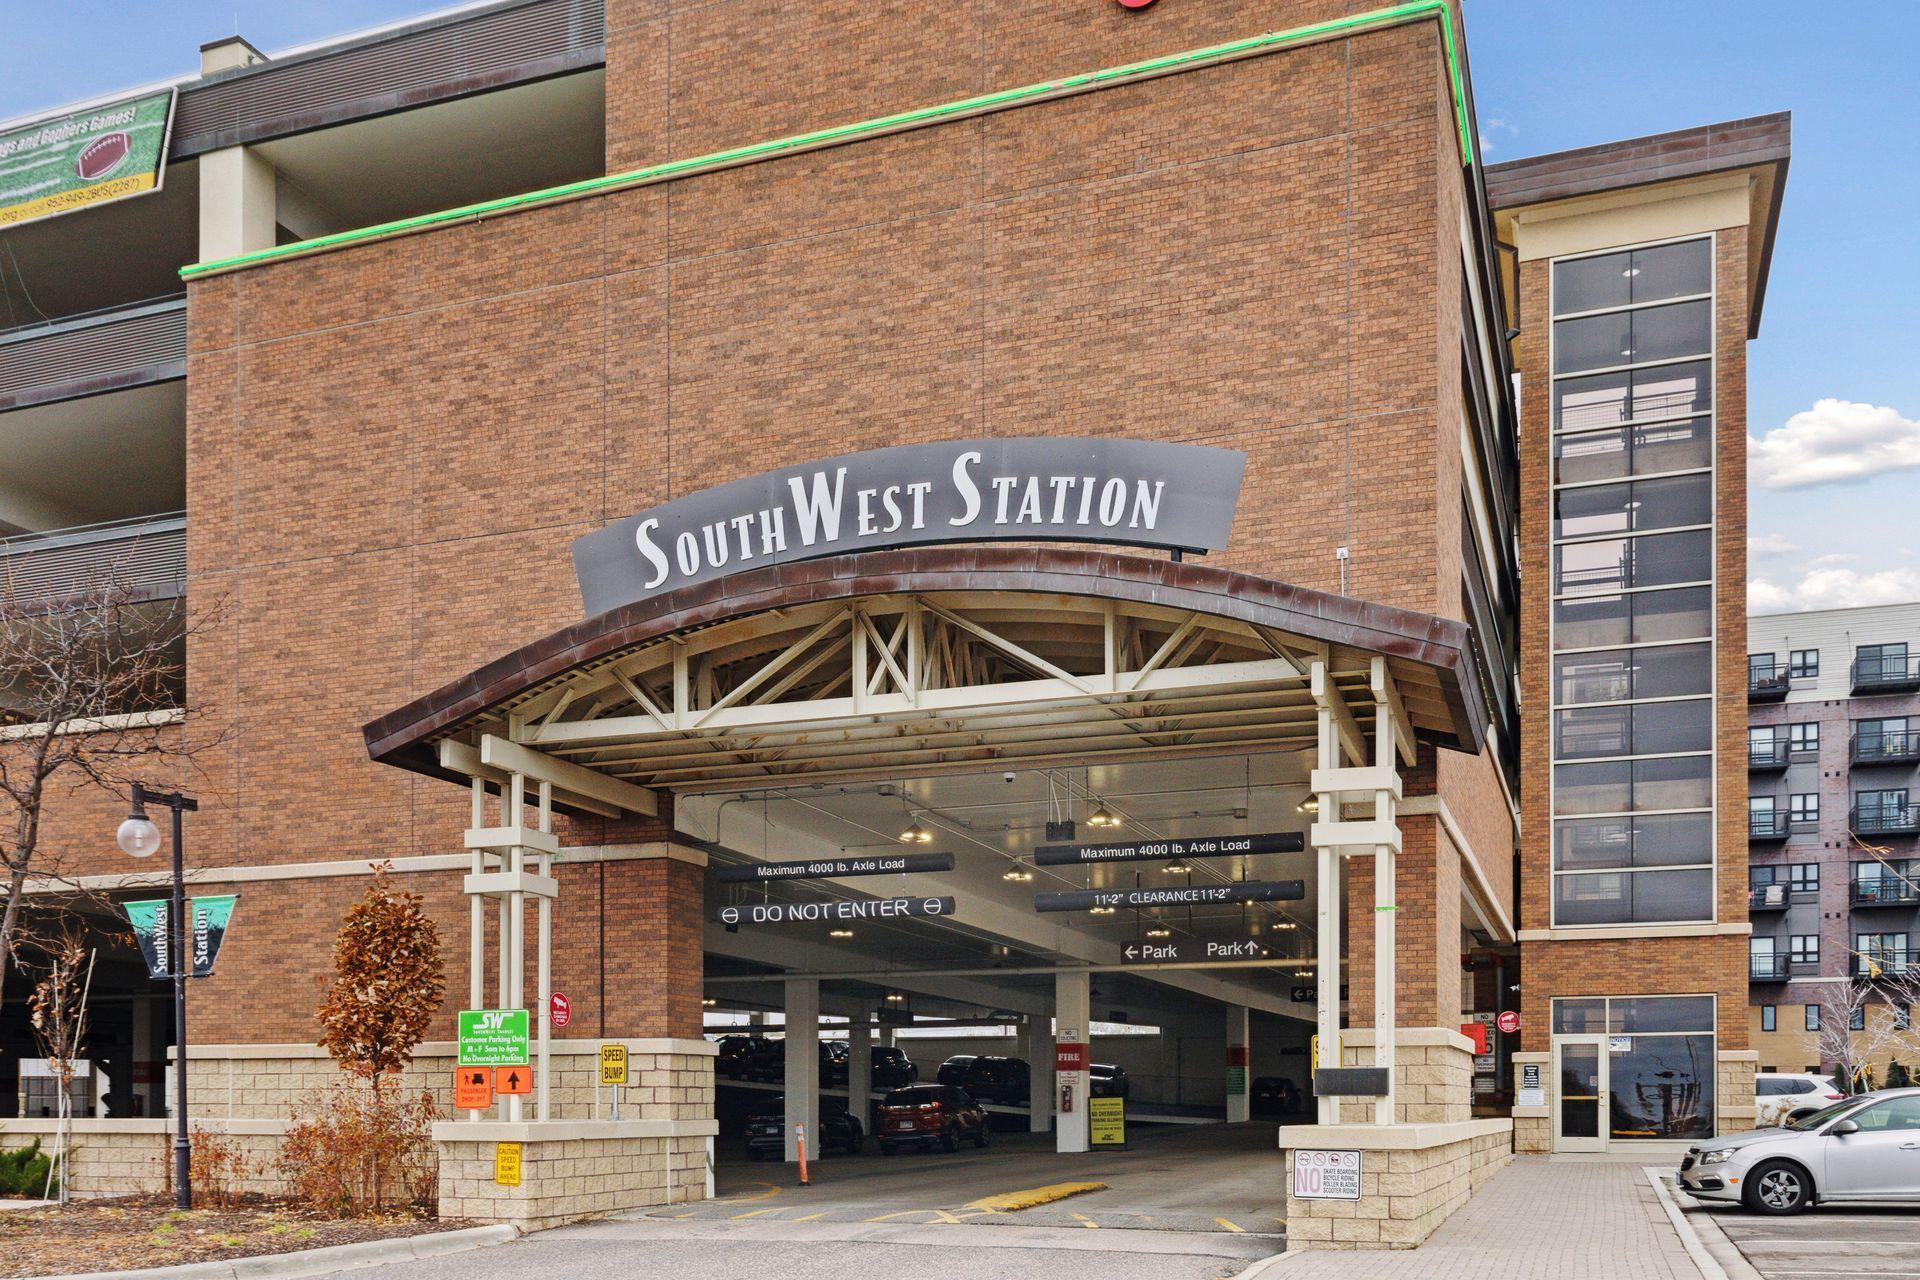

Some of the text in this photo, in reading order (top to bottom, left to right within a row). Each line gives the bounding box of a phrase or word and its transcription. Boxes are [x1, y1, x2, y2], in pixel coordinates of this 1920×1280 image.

[17, 131, 41, 151] and
[41, 121, 89, 143] Gophers
[89, 107, 136, 132] Games!
[1080, 838, 1250, 859] Maximum 4000 lb. Axle Load
[757, 858, 905, 877] Maximum 4000 lb. Axle Load
[1129, 890, 1199, 904] CLEARANCE
[753, 900, 910, 922] DO NOT ENTER
[153, 905, 167, 973] SouthWest
[194, 909, 208, 965] Station
[1142, 944, 1177, 958] Park
[1207, 941, 1243, 956] Park
[461, 1035, 525, 1044] Customer Parking Only
[472, 1054, 501, 1064] Overnight
[502, 1054, 524, 1063] Parking
[604, 1049, 623, 1061] SPEED
[1058, 1053, 1080, 1061] FIRE
[605, 1067, 623, 1079] BUMP
[1296, 1167, 1321, 1193] NO
